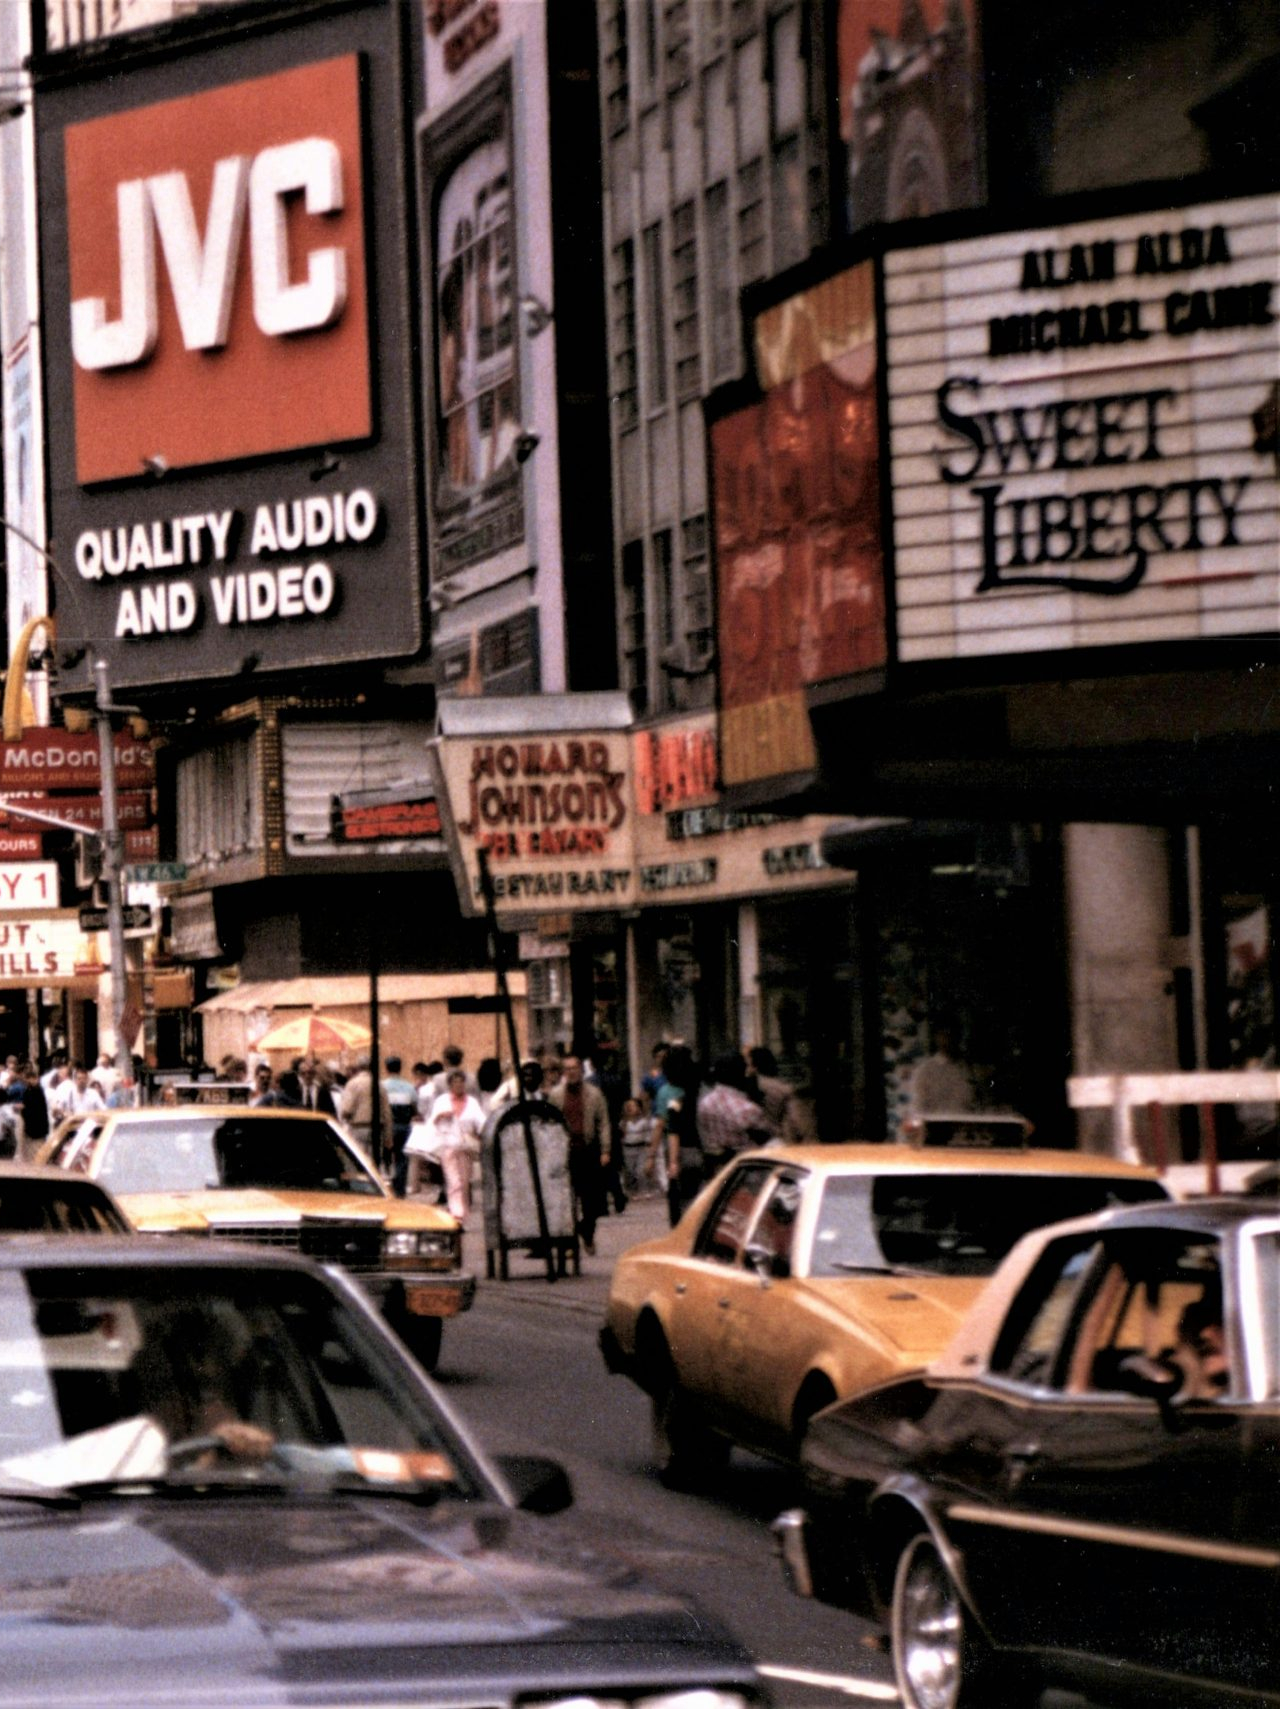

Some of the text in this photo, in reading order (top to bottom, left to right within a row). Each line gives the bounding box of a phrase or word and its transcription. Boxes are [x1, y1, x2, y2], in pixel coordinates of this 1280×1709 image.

[71, 136, 348, 371] JVC
[1021, 225, 1231, 289] ALAN ALDA
[989, 300, 1149, 356] MICHAEL
[75, 489, 377, 580] QUALITY AUDIO
[116, 563, 335, 637] AND VIDEO
[5, 746, 154, 768] McDonld's
[471, 741, 609, 779] HOWARD
[90, 806, 145, 820] HURS
[35, 872, 49, 899] 1
